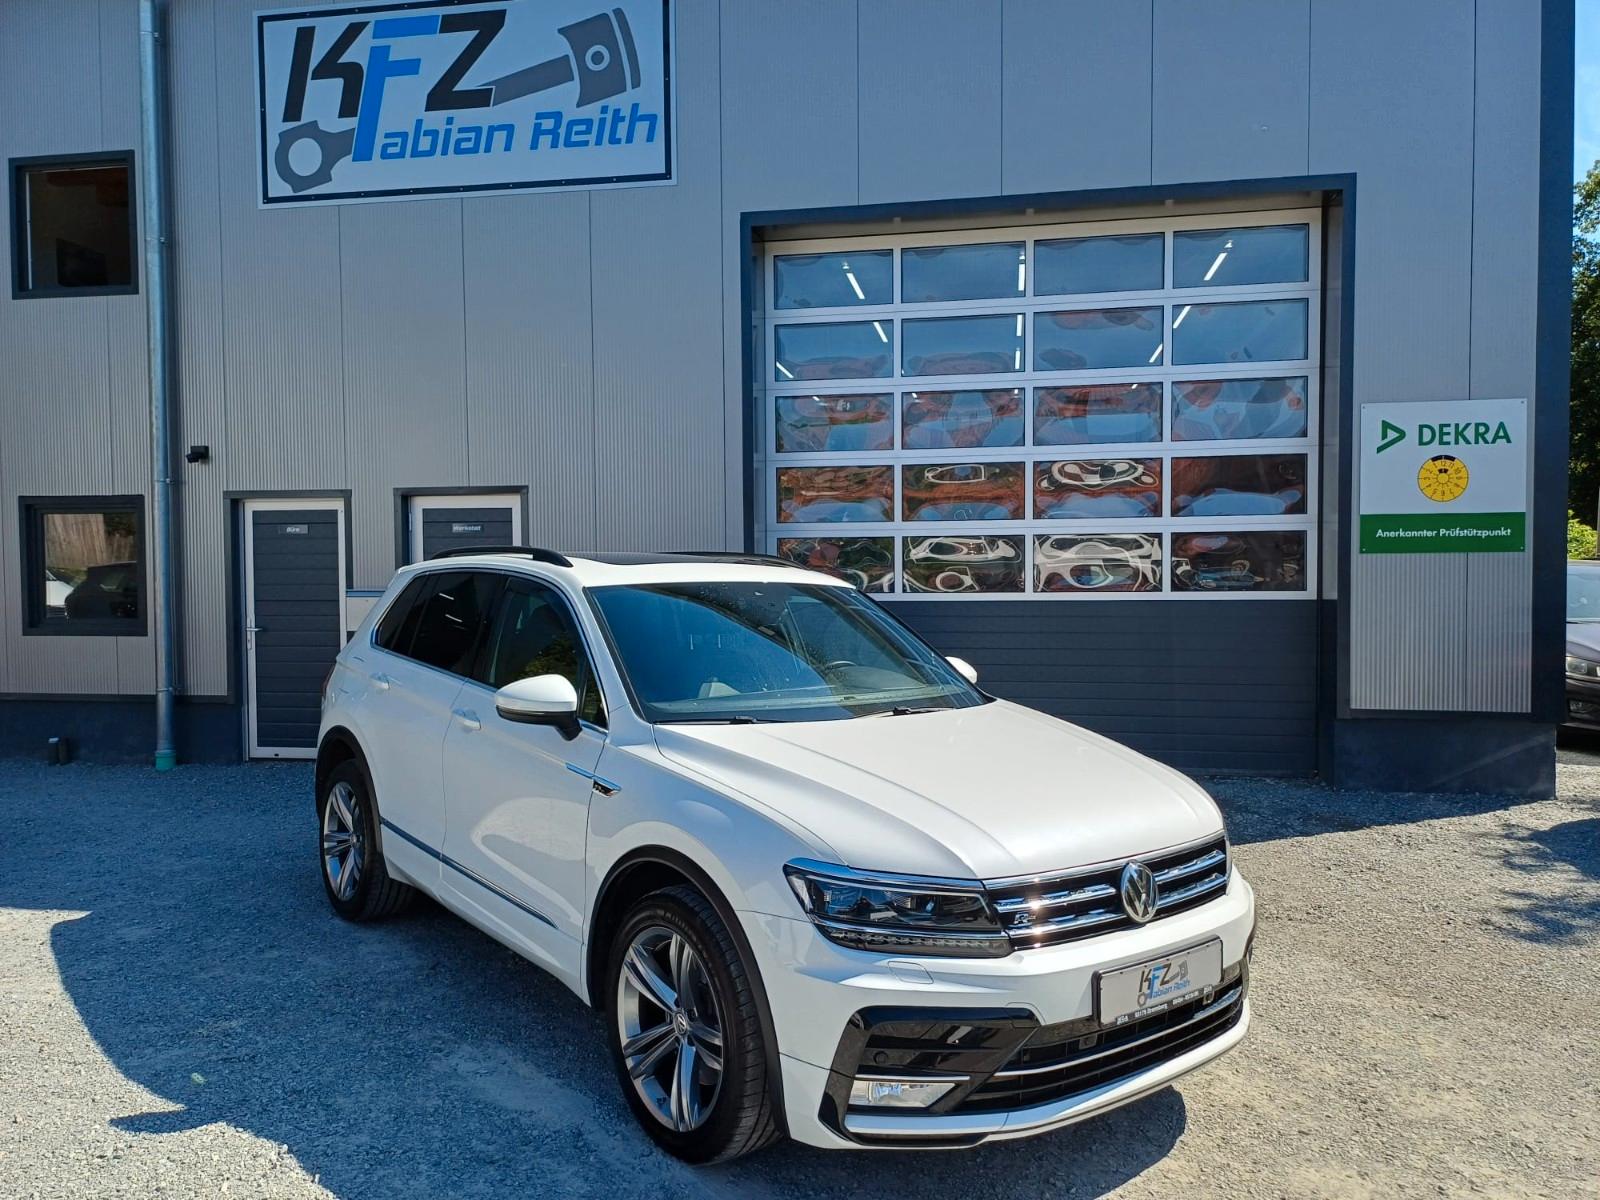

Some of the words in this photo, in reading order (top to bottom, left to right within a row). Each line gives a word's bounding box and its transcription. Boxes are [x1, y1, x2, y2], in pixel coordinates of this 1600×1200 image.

[282, 9, 507, 162] KFZ
[529, 102, 659, 151] Reith
[1417, 421, 1512, 446] DEKRA
[1375, 528, 1437, 538] Anerkannter
[1439, 527, 1512, 539] Prüfstützpunkt
